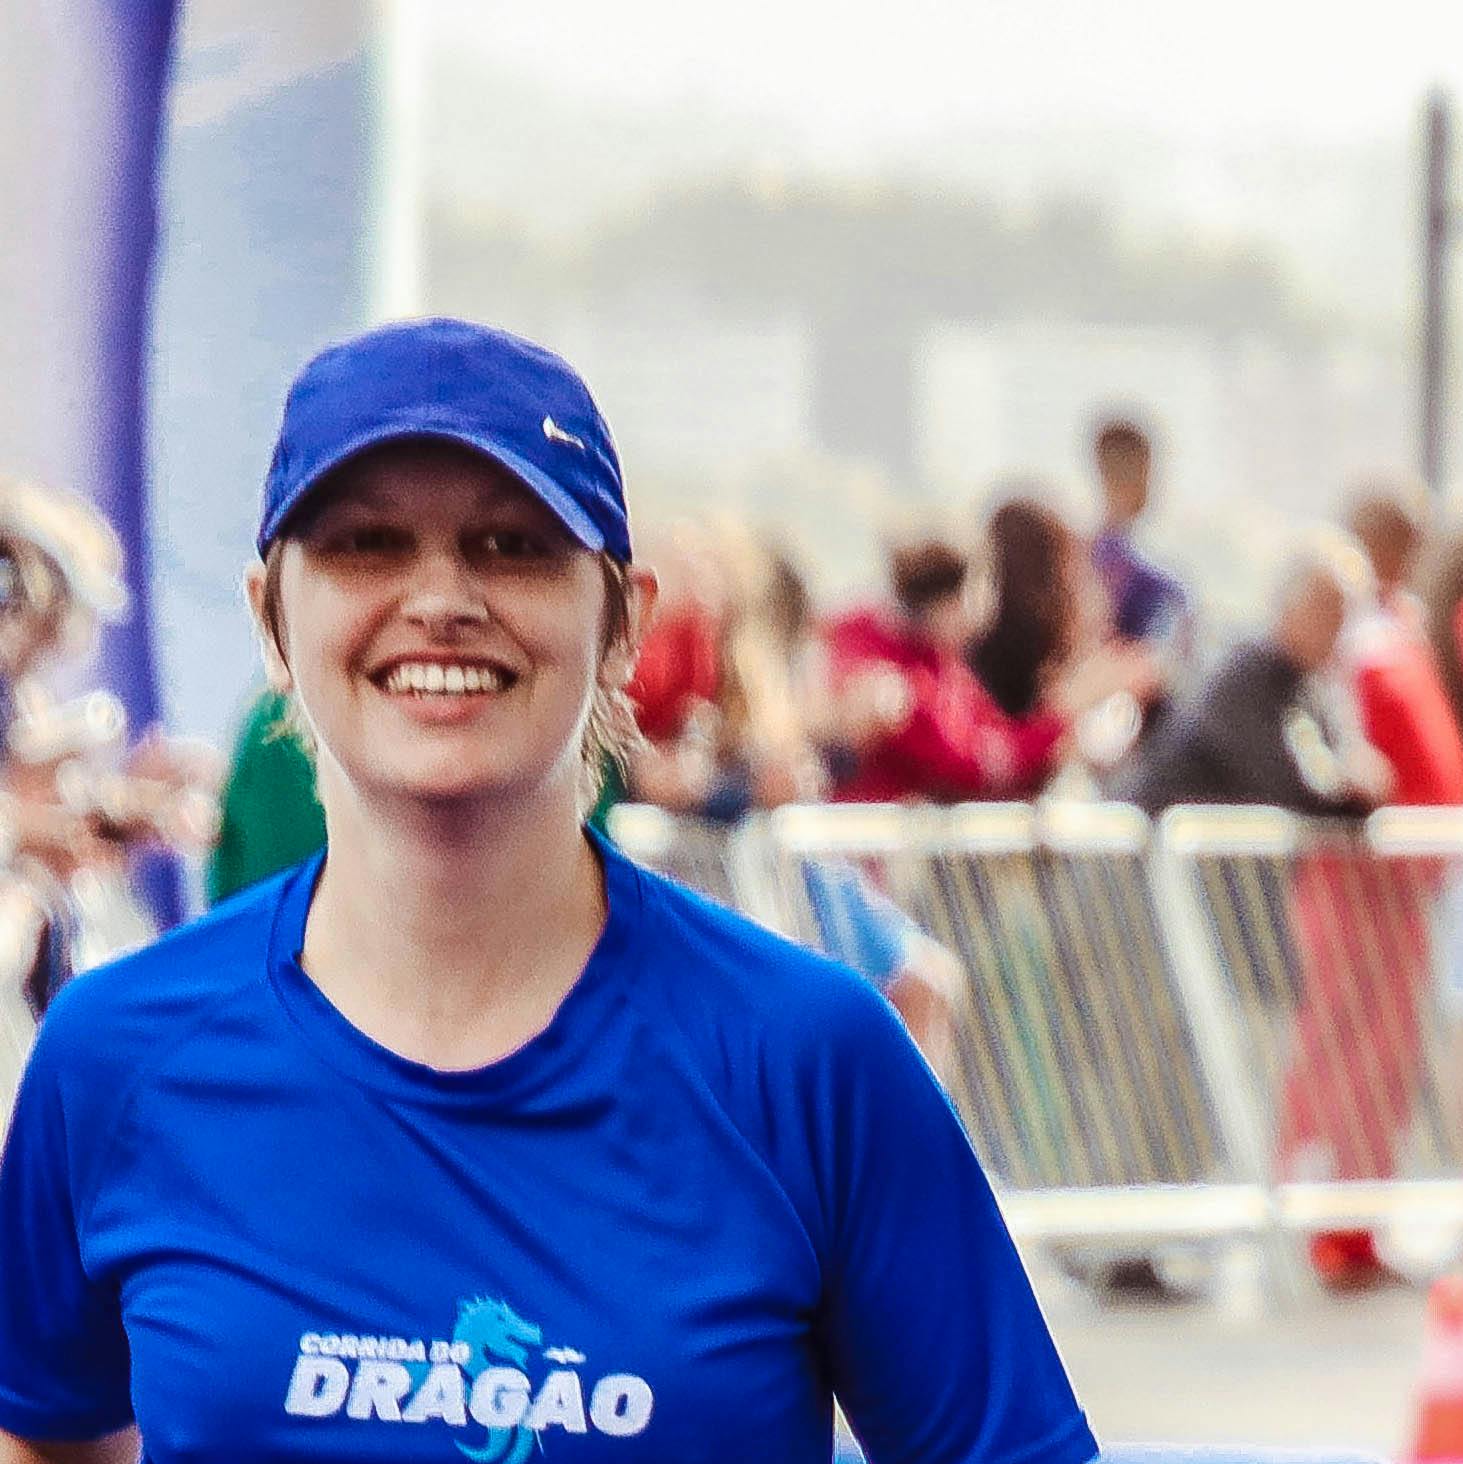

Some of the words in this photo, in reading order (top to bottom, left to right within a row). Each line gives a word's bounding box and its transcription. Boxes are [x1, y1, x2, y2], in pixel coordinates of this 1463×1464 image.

[299, 1331, 426, 1363] CORRIDA
[429, 1339, 471, 1365] DO
[284, 1345, 654, 1438] DRAGÃO
